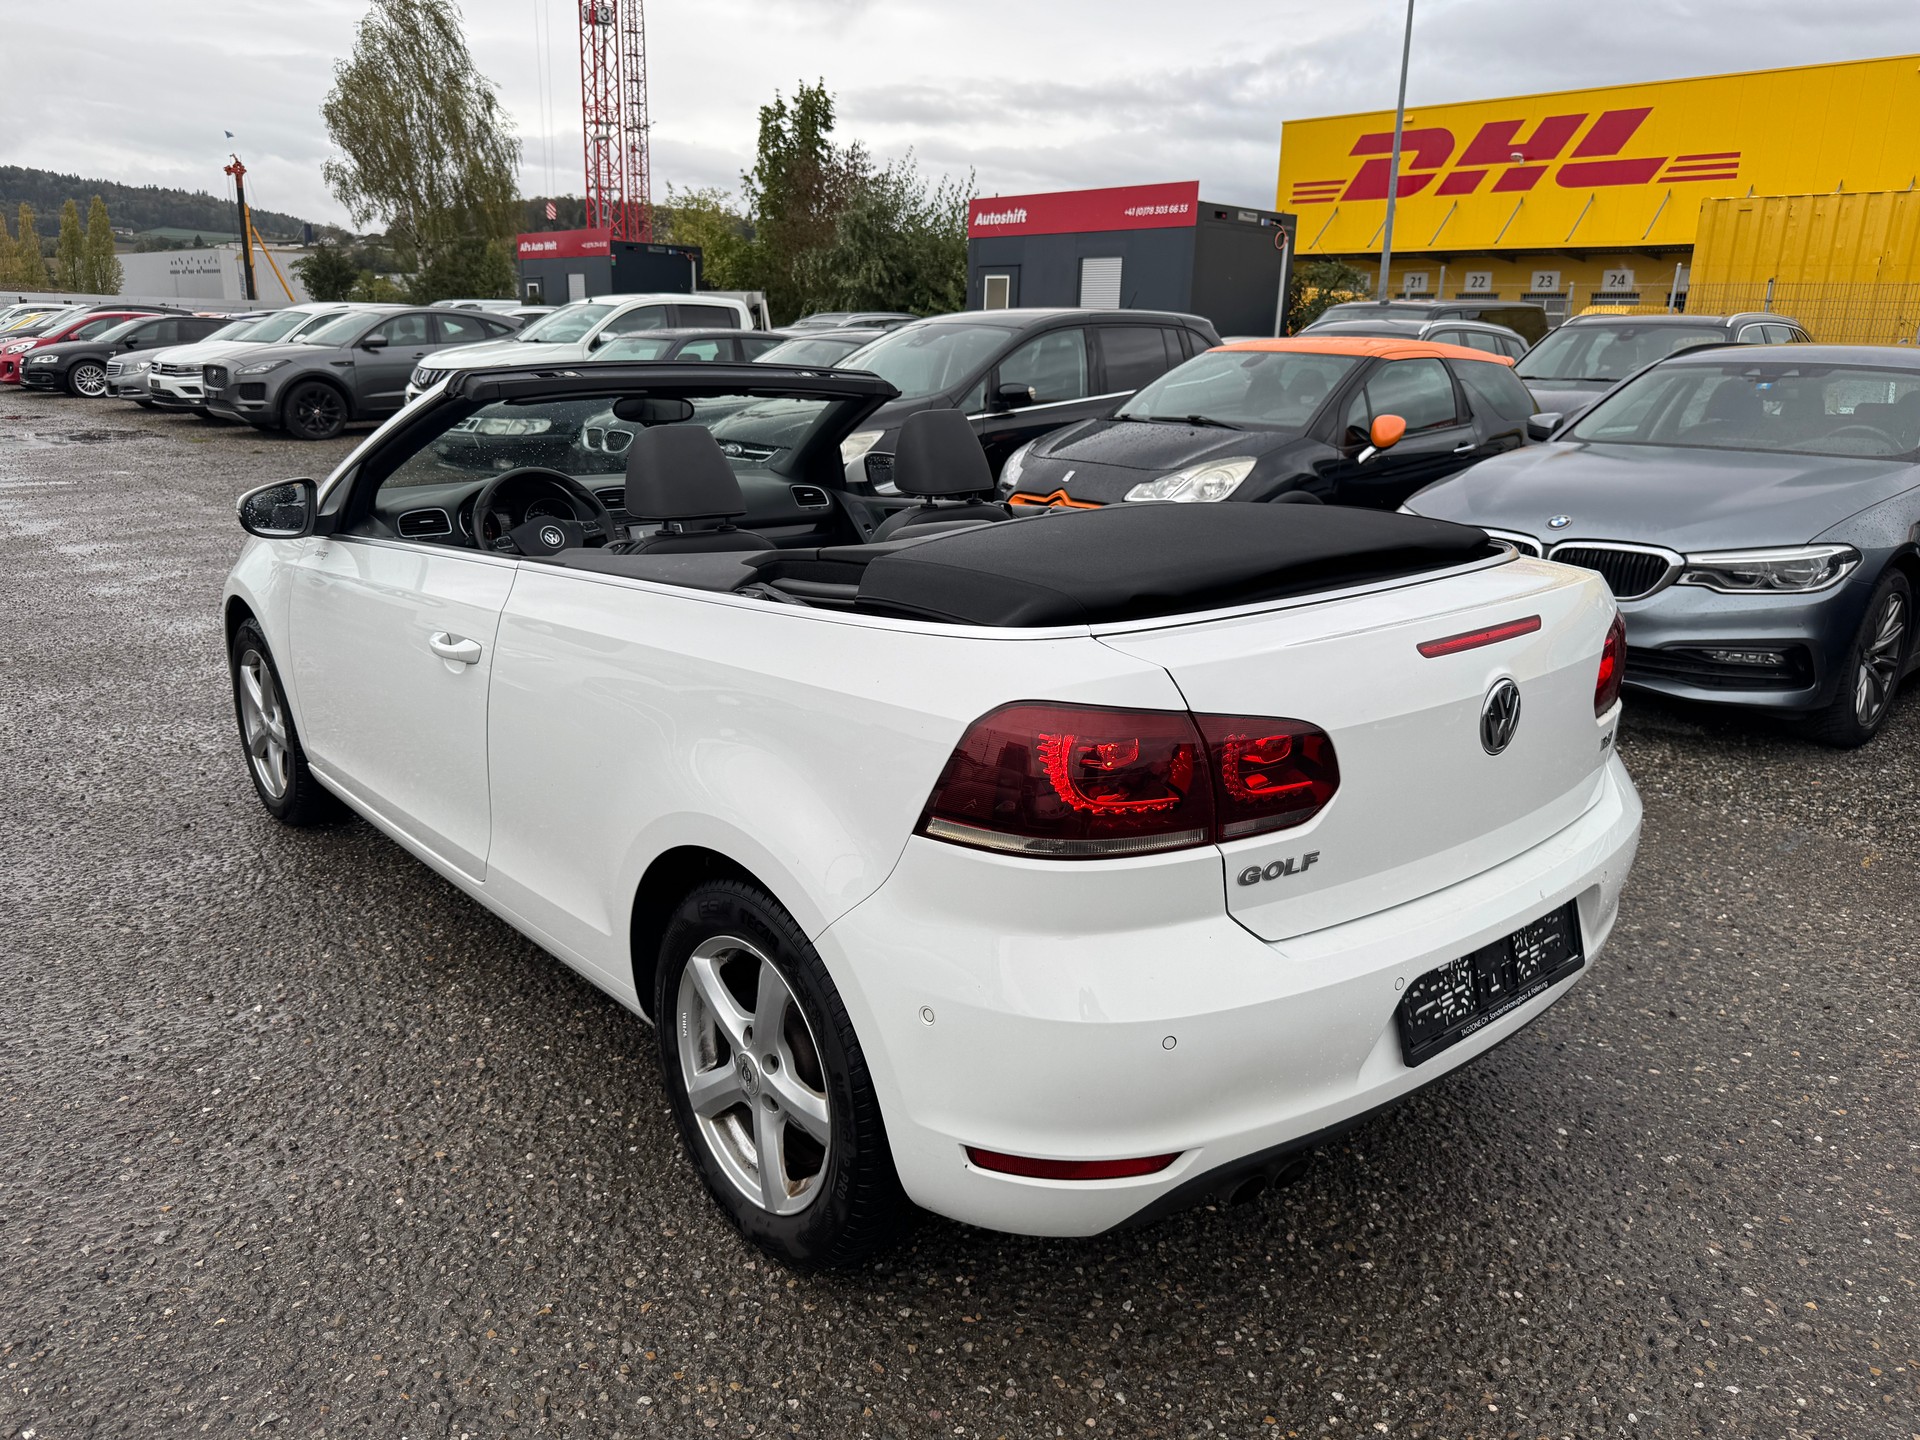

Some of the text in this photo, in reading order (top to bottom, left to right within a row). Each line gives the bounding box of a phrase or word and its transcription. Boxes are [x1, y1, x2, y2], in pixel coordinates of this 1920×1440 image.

[600, 7, 610, 21] 3
[1340, 106, 1668, 201] DHL
[974, 208, 1027, 226] Autoshift
[1124, 207, 1135, 216] +41
[531, 242, 544, 251] Auto
[1410, 276, 1422, 288] 21
[1471, 276, 1486, 288] 22
[1537, 275, 1553, 288] 23
[1609, 274, 1625, 287] 24
[1237, 850, 1320, 886] GOLF
